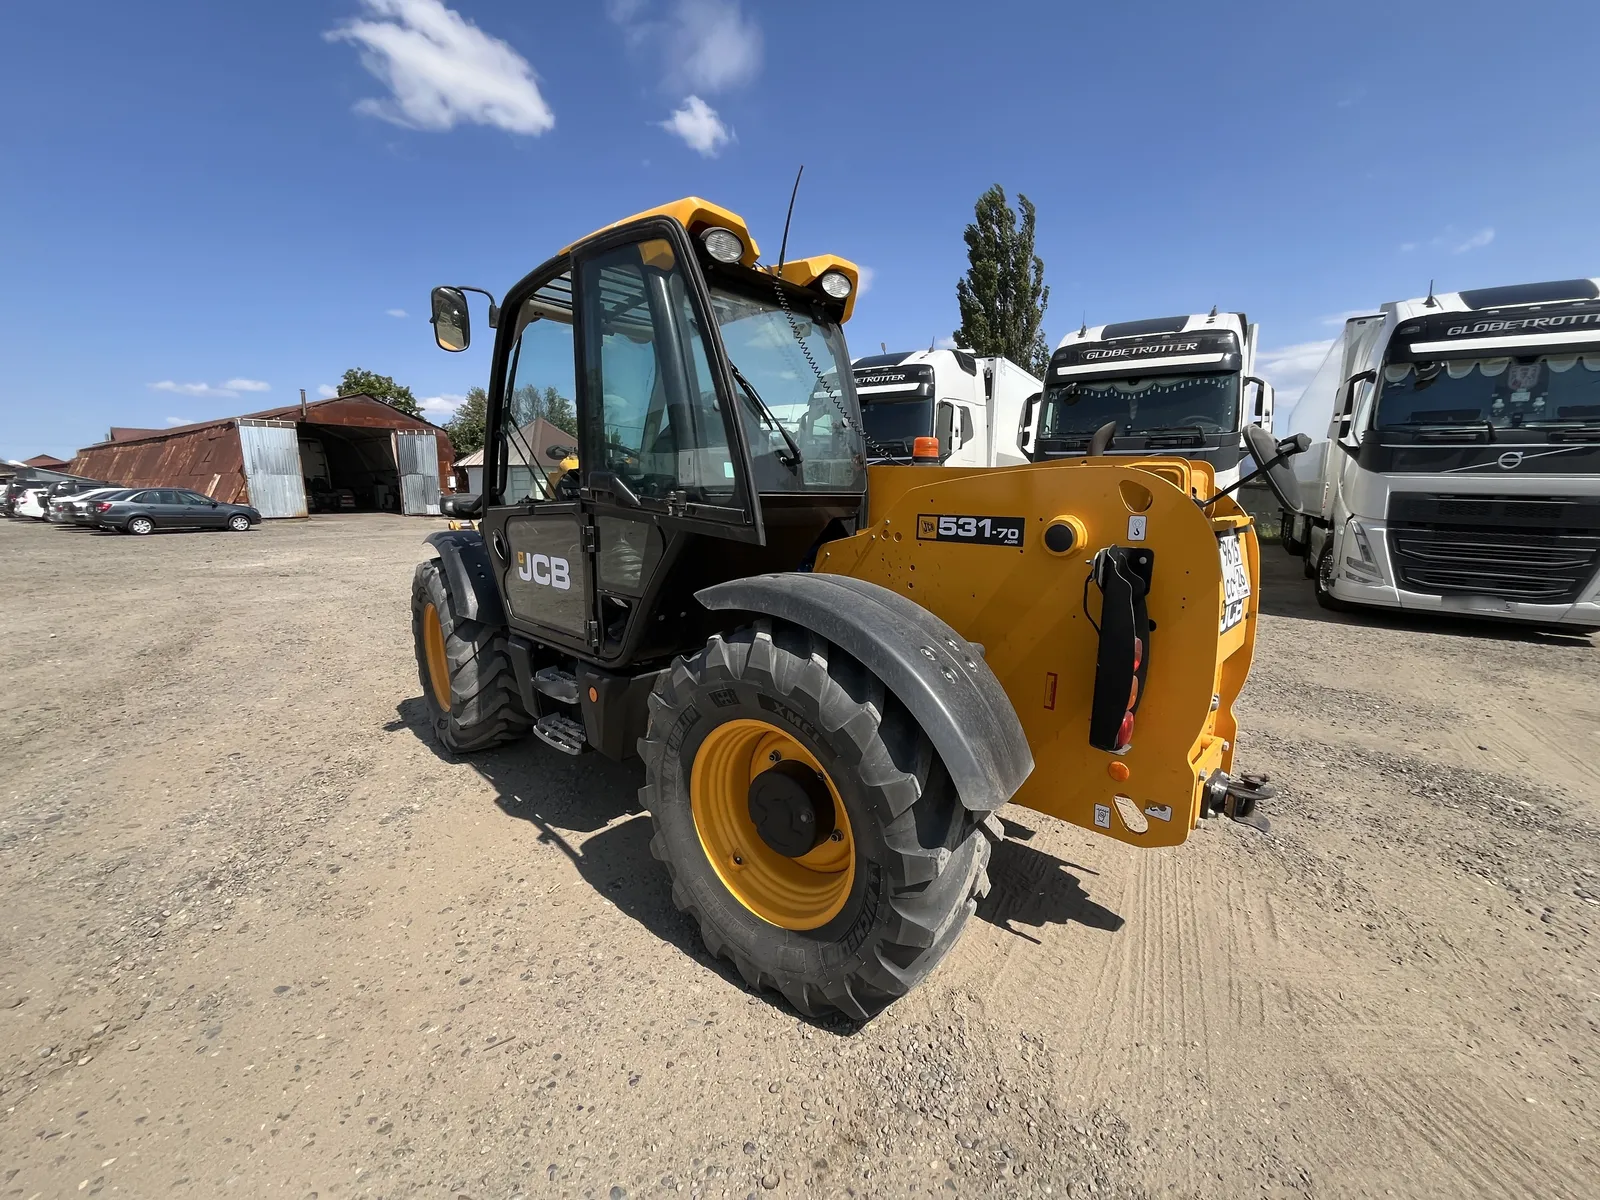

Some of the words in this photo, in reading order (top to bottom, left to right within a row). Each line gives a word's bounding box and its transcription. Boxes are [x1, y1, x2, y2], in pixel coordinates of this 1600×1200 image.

[1086, 342, 1198, 360] GLOBETROTTER
[938, 517, 1019, 539] 531-70
[518, 552, 571, 590] JCB
